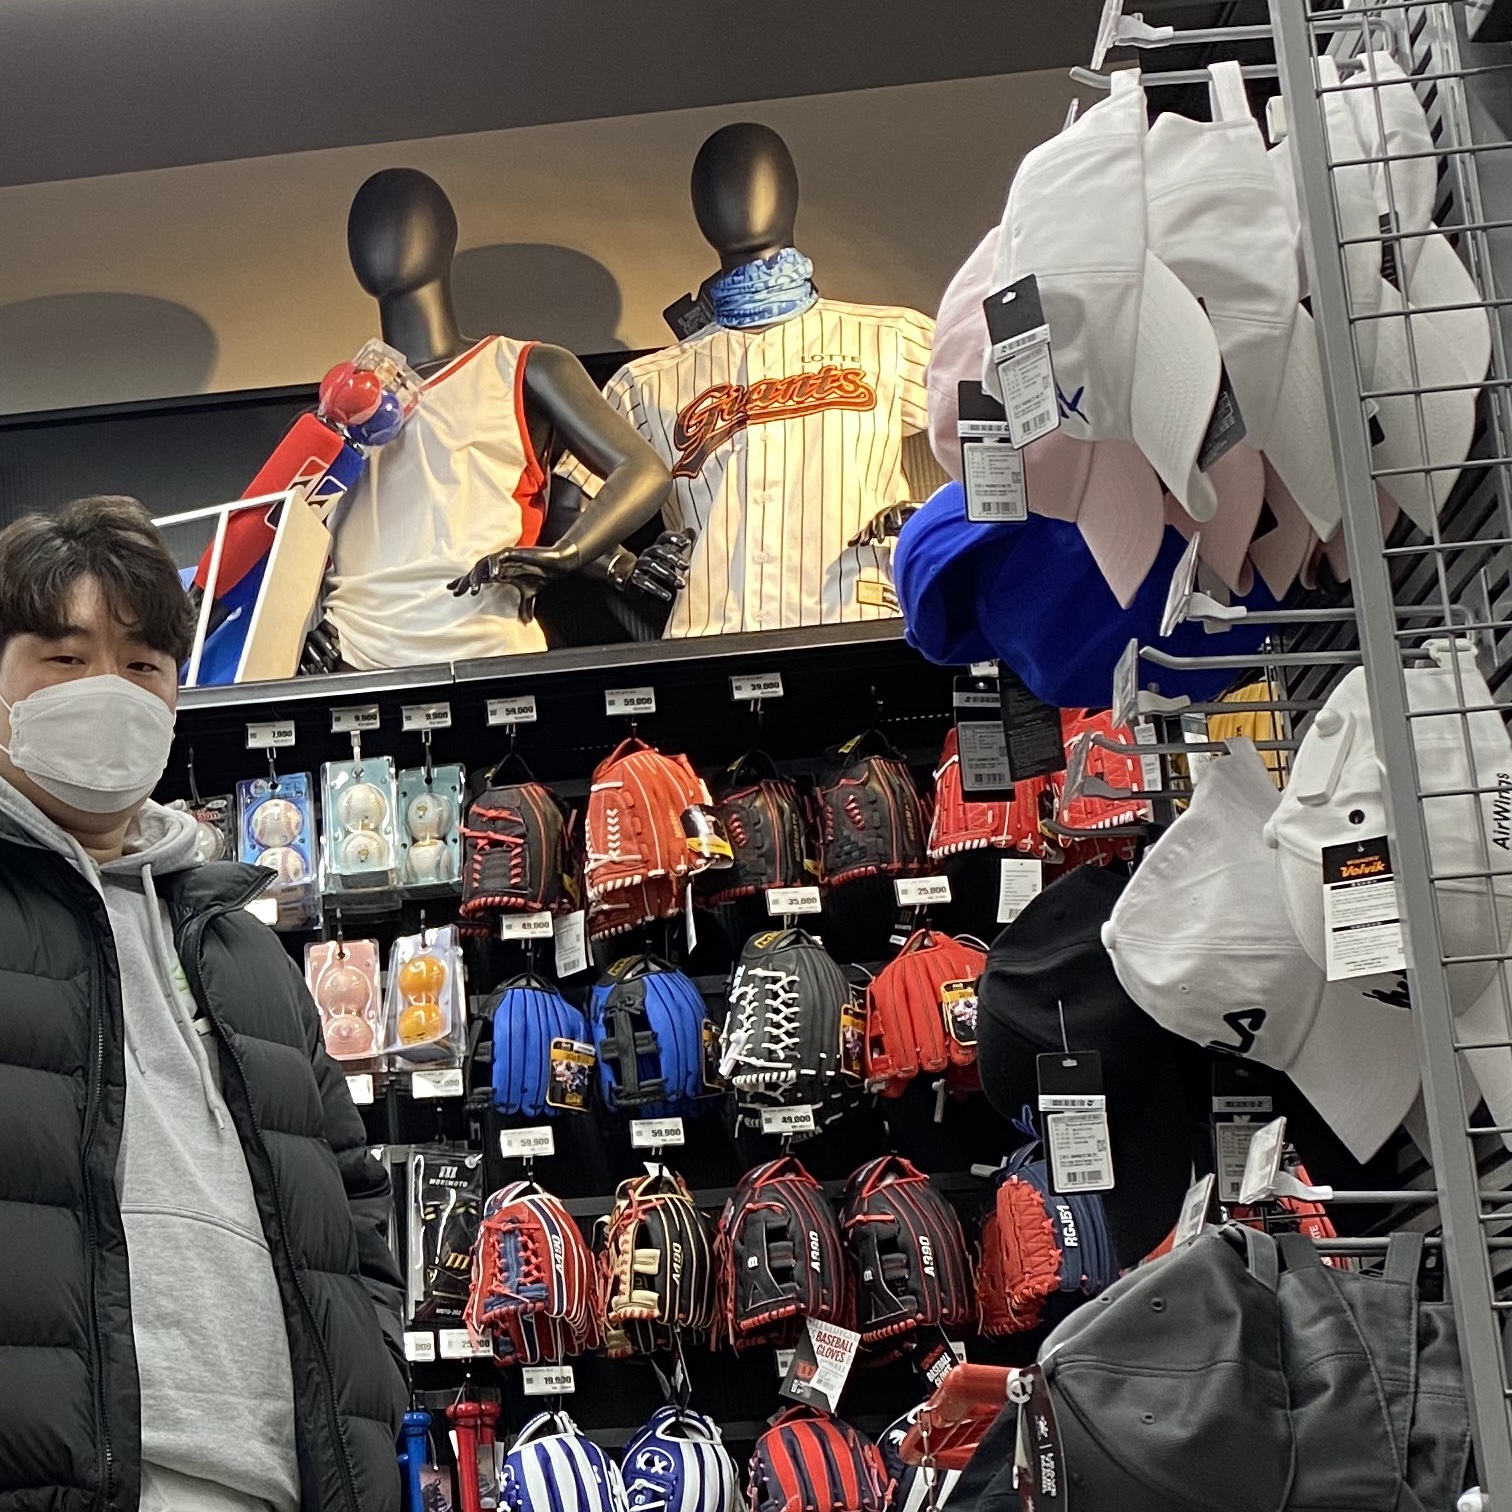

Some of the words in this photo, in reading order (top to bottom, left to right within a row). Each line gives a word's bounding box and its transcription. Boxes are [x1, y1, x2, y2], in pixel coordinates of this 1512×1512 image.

[801, 354, 861, 364] LOTTE
[673, 365, 874, 468] Giants
[1340, 859, 1386, 879] Volvik
[429, 1178, 468, 1188] MORIMOTO
[815, 1331, 854, 1353] BASEBALL
[815, 1343, 846, 1363] GLOVES
[926, 1351, 952, 1384] BASEBALL
